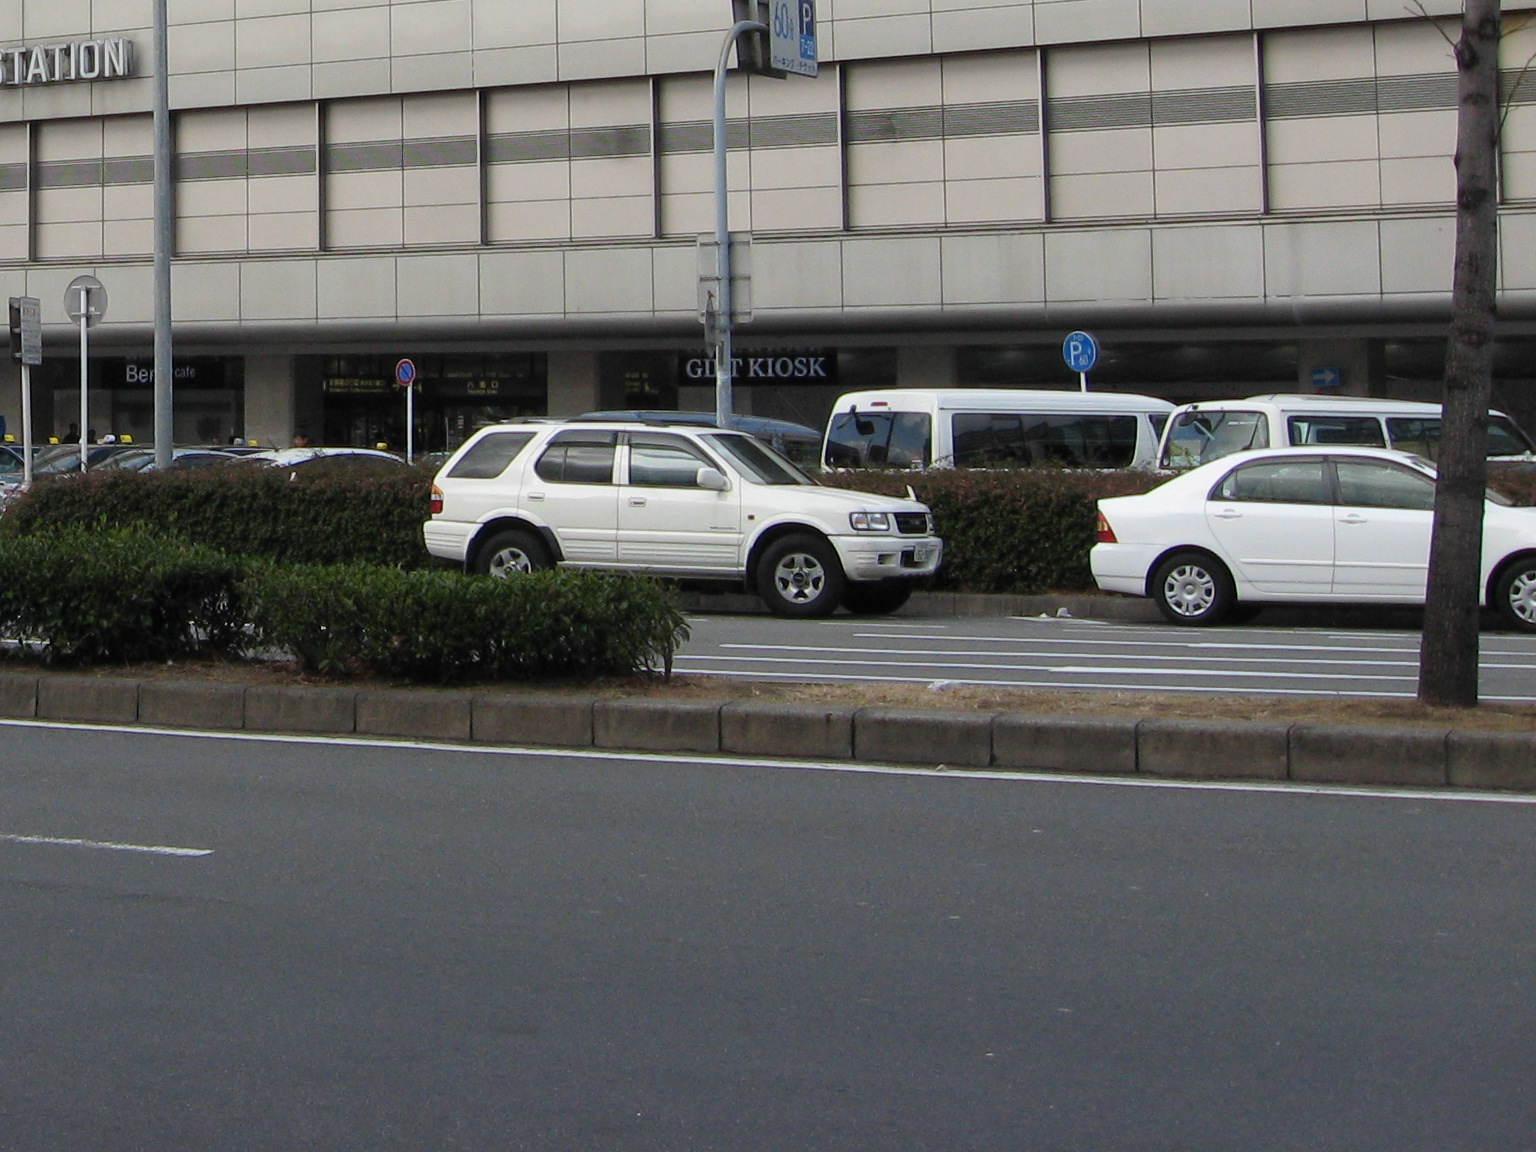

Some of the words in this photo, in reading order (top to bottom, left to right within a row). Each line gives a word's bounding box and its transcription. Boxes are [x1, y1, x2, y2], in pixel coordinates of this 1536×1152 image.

[803, 3, 812, 36] P
[1070, 341, 1082, 365] P
[174, 366, 196, 378] cafe
[686, 358, 743, 378] GIT
[748, 357, 826, 377] KIOSK
